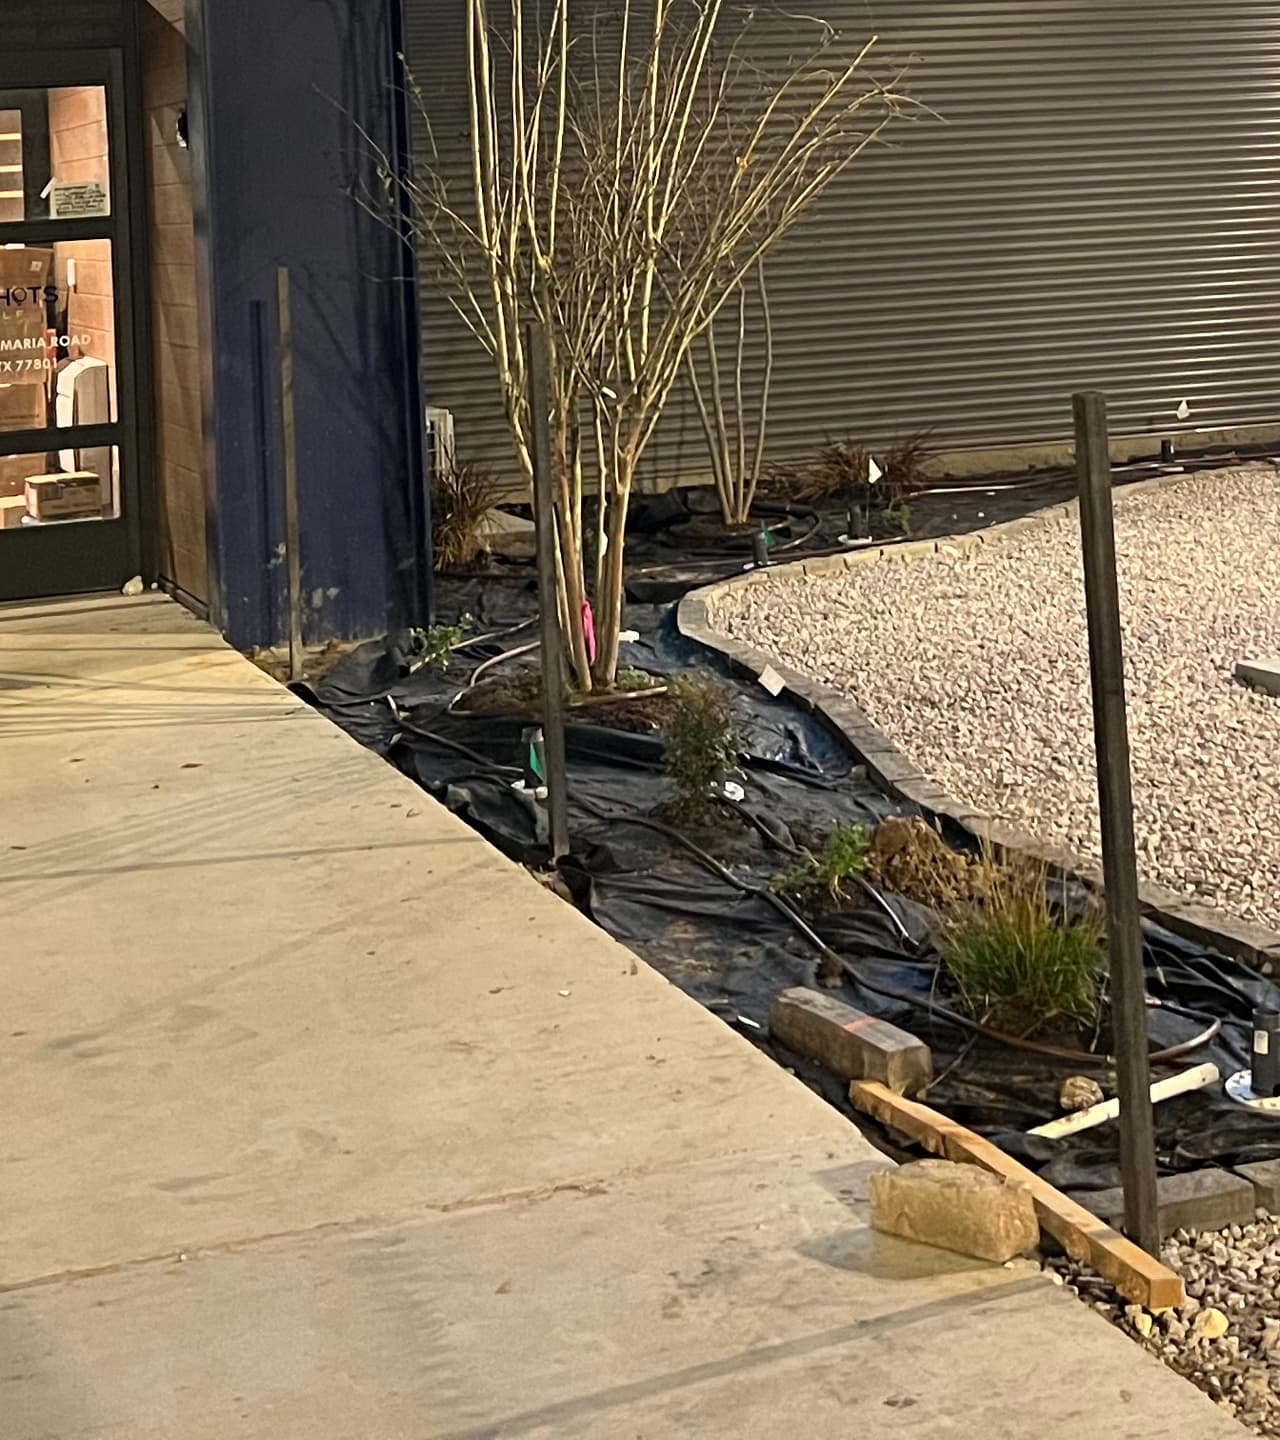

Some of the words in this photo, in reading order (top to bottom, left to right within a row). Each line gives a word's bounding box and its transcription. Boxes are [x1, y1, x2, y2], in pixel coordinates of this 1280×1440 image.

[0, 337, 46, 351] MARIA
[49, 334, 91, 348] ROAD
[15, 358, 58, 372] 77801
